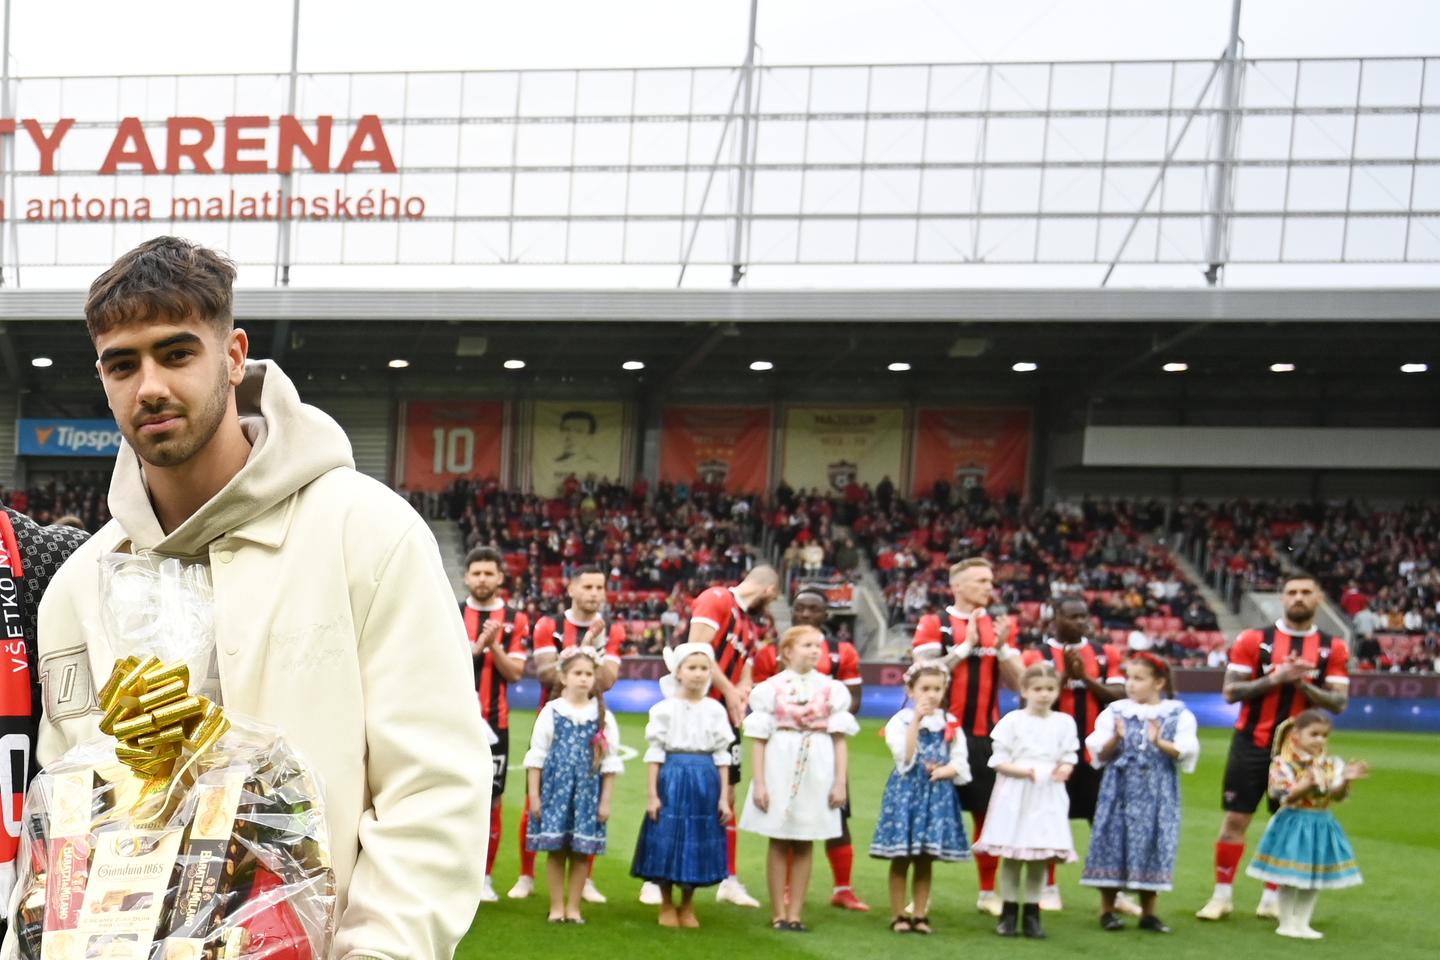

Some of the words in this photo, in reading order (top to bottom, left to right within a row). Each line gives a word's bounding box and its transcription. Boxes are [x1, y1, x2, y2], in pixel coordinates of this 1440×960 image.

[97, 114, 398, 176] ARENA
[26, 193, 152, 222] antona
[170, 189, 426, 222] malatinského
[57, 426, 122, 451] Tipspo
[432, 427, 475, 474] 10
